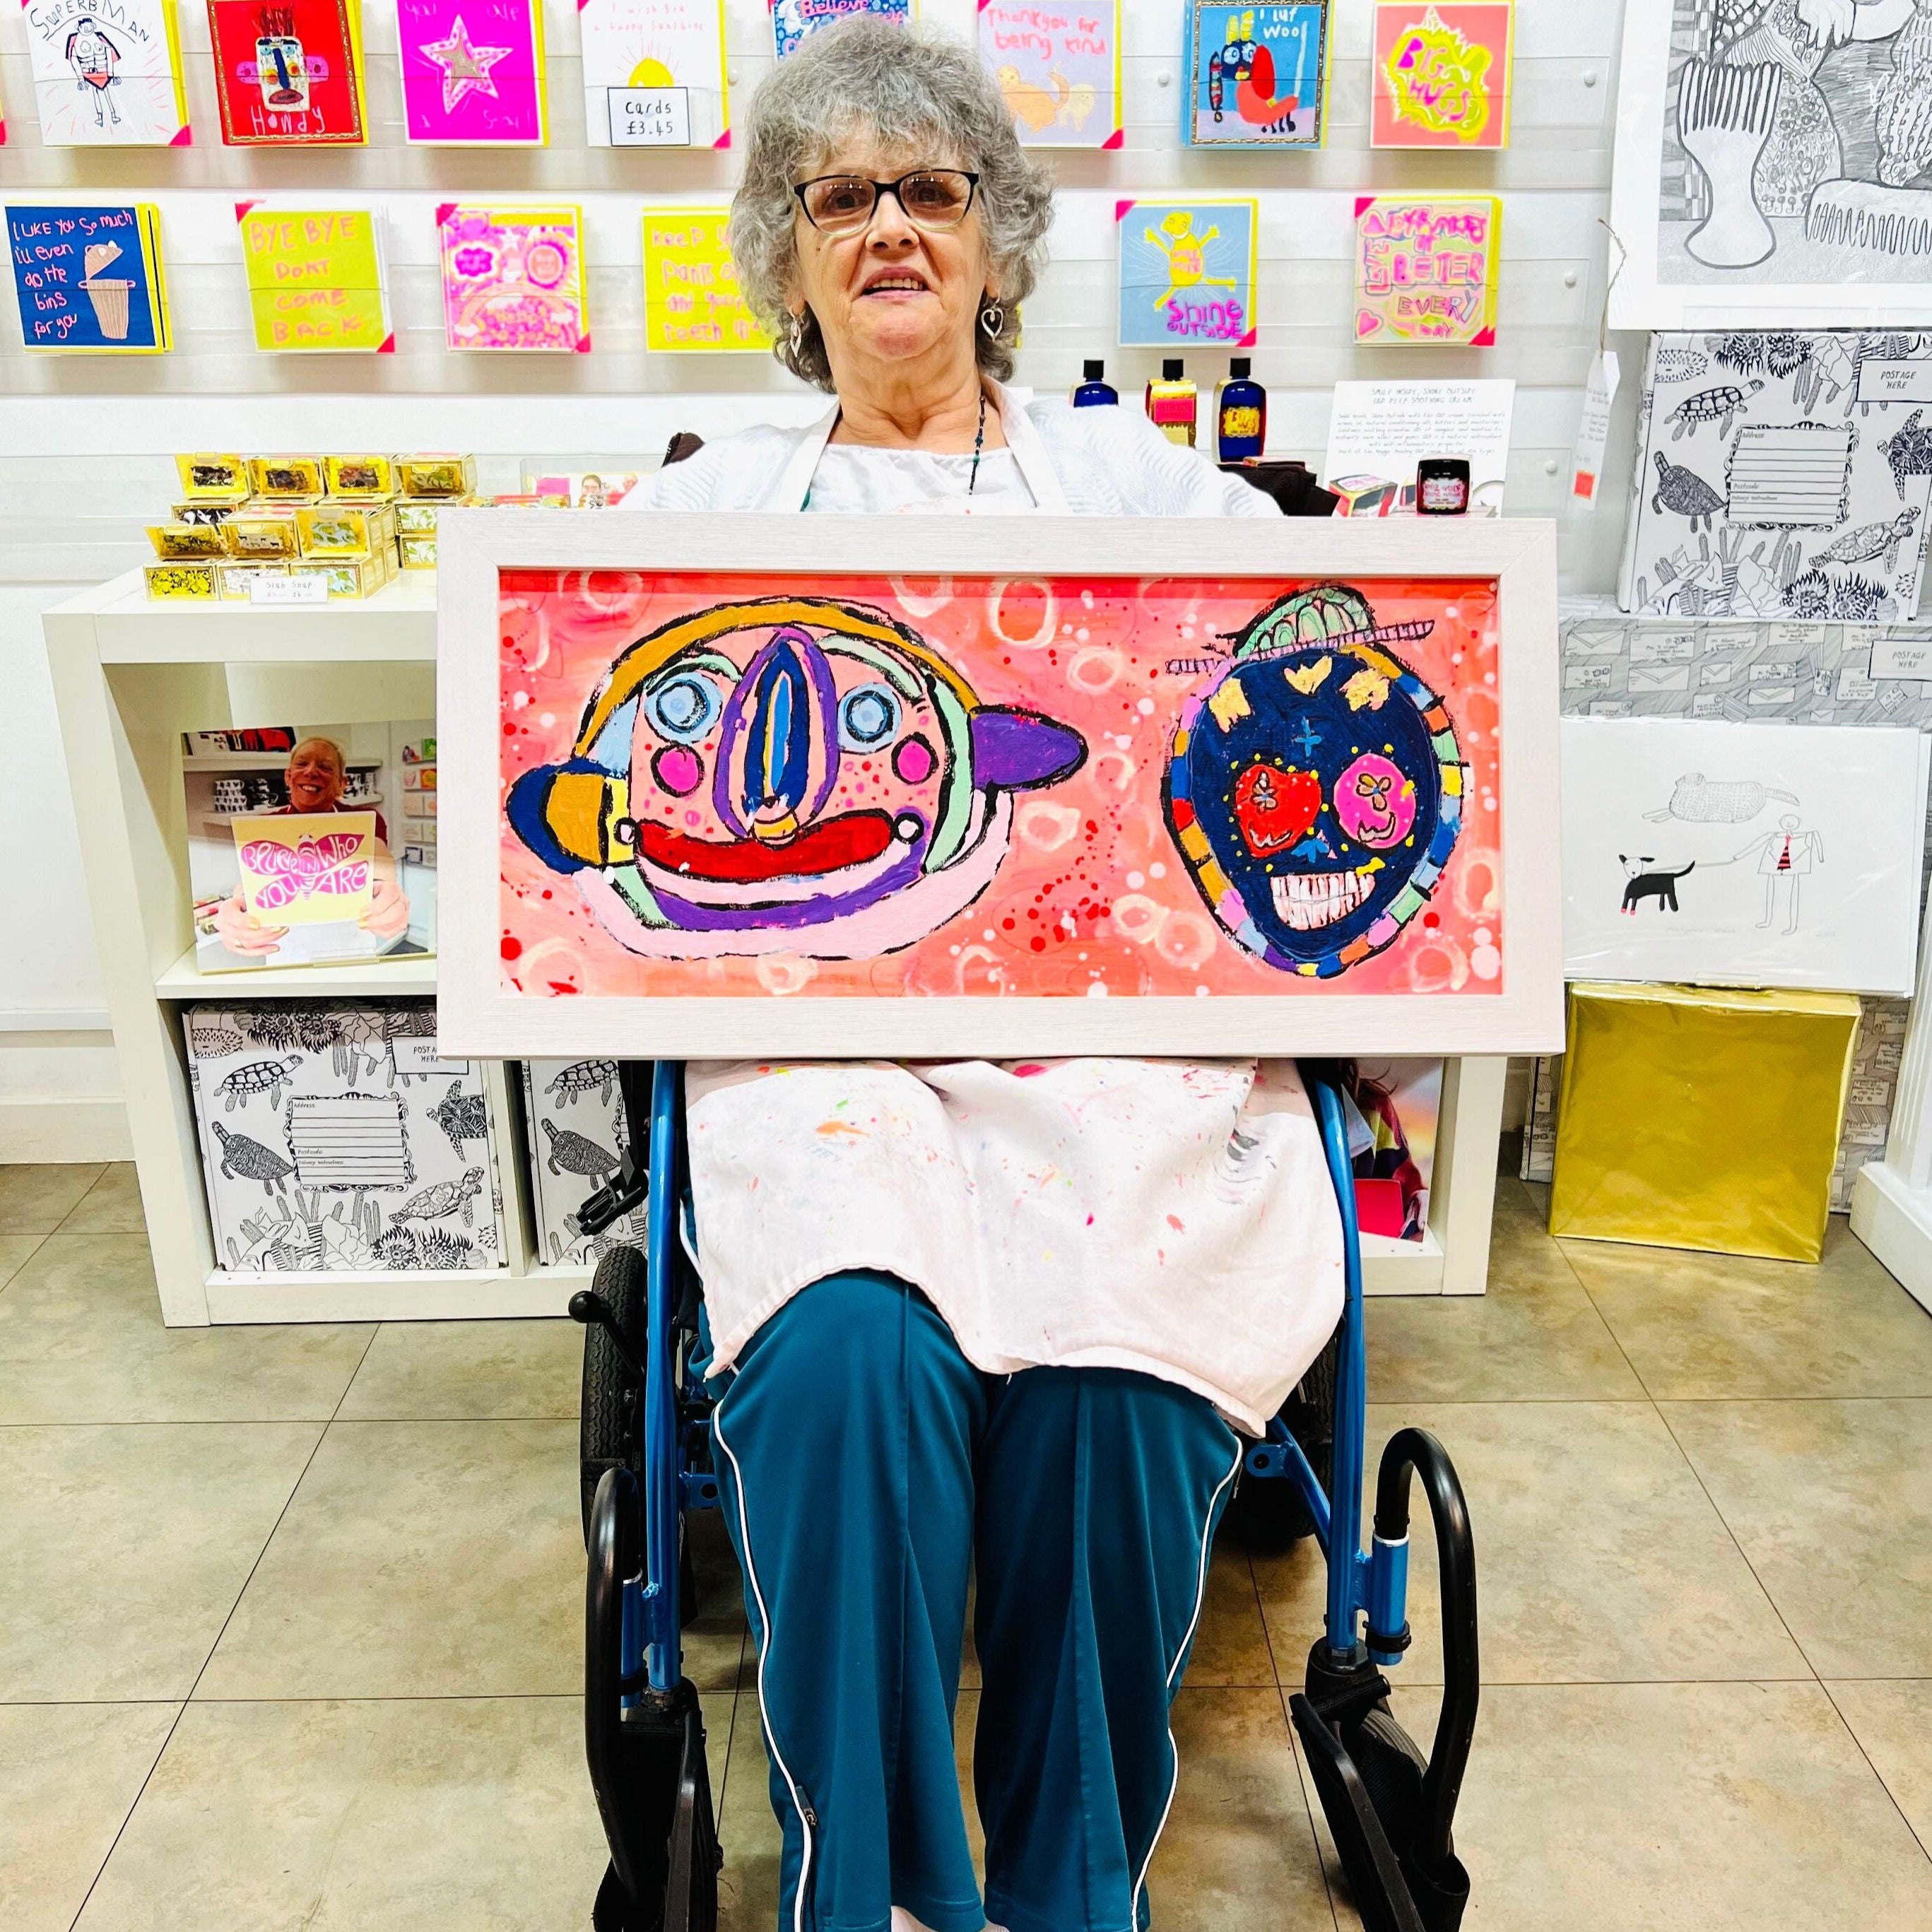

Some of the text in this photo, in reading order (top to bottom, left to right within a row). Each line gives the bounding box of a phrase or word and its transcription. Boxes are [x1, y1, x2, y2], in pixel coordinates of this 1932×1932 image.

[1260, 8, 1265, 20] I
[994, 31, 1052, 61] being
[251, 105, 325, 136] Howdy
[627, 120, 673, 136] £3.45
[21, 222, 52, 237] LIKE
[249, 215, 355, 254] BYE BYE
[35, 244, 74, 261] even
[25, 263, 68, 288] do the
[276, 288, 348, 311] COME
[1398, 290, 1478, 323] EVERY
[1167, 298, 1243, 325] Shine
[34, 313, 78, 339] for you
[273, 316, 363, 343] BACK
[1419, 322, 1454, 338] DAY
[1880, 370, 1916, 380] POSTAGE
[1886, 380, 1908, 389] HERE
[1892, 651, 1926, 660] POSTAGE
[257, 873, 300, 909] YOU
[413, 1046, 437, 1055] POSTA
